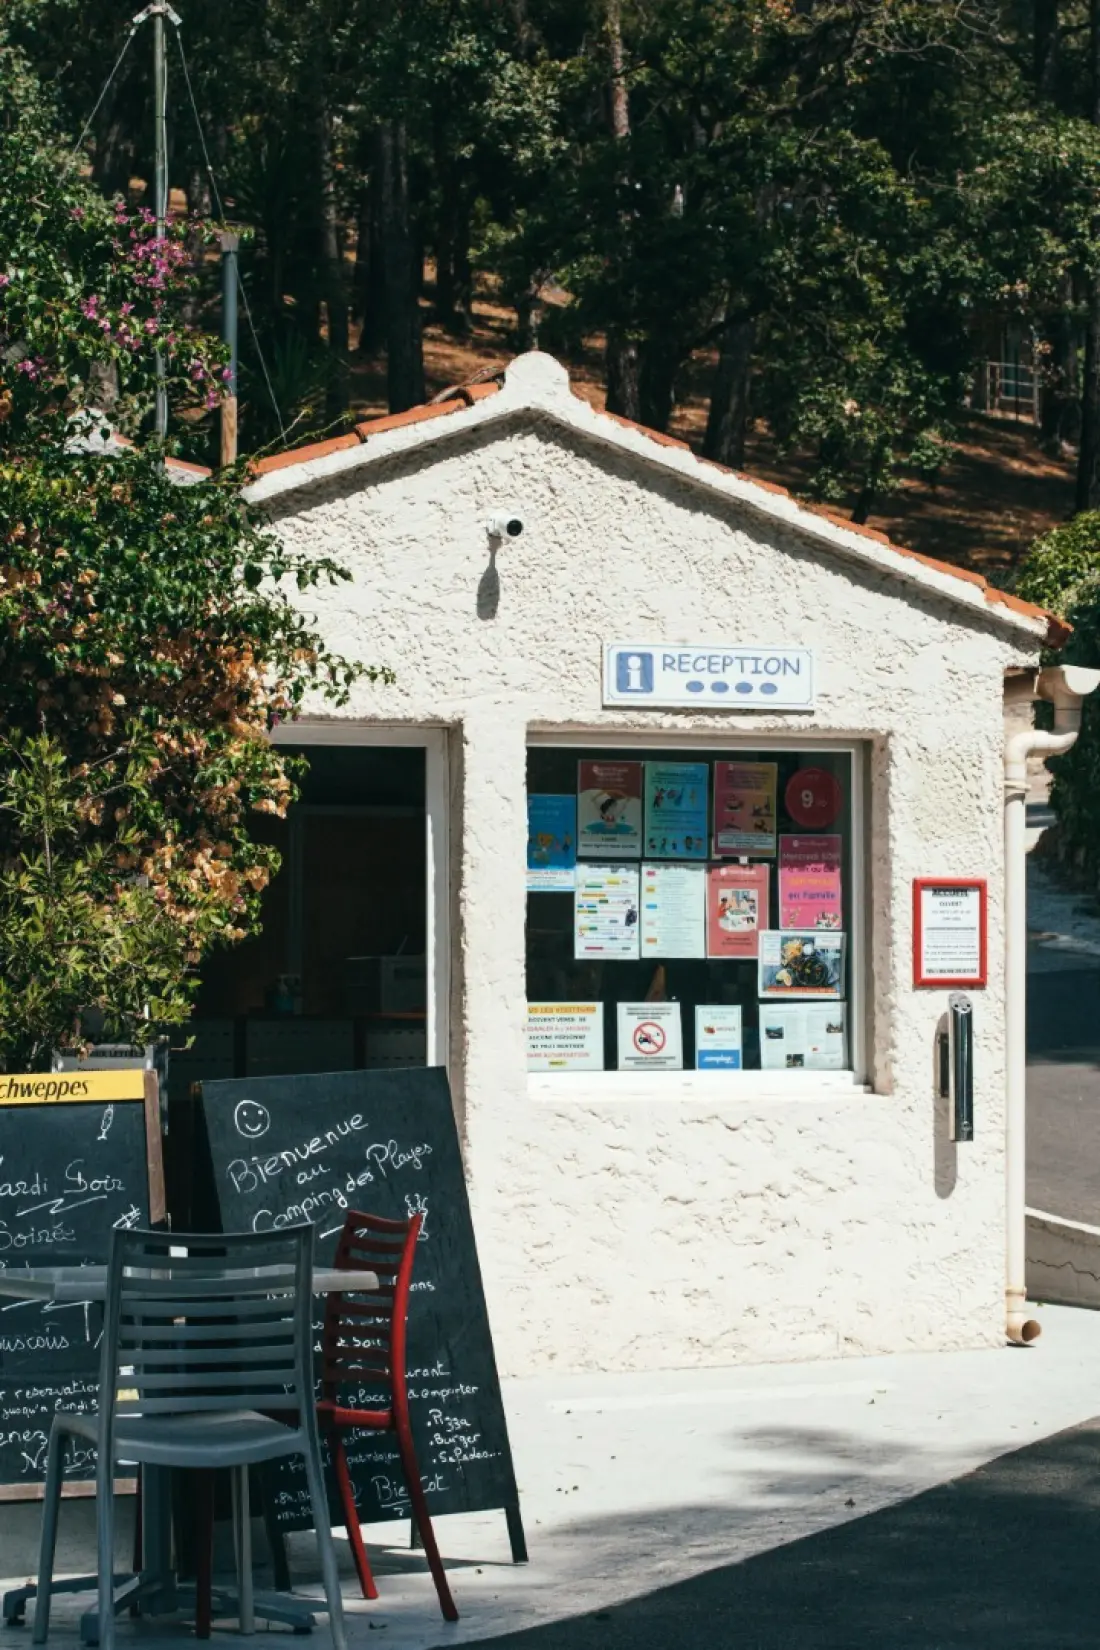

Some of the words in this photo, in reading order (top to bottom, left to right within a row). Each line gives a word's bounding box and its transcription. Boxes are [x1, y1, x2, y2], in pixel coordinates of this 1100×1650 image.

[661, 653, 801, 676] RECEPTION
[0, 1077, 91, 1100] chweppes
[226, 1113, 369, 1194] Bienvenue
[0, 1165, 48, 1197] ardi
[296, 1162, 331, 1185] au
[252, 1186, 349, 1233] Camping
[345, 1166, 375, 1193] des
[0, 1335, 70, 1352] uscous
[428, 1408, 472, 1432] Pizza
[0, 1429, 48, 1448] enez
[433, 1432, 482, 1448] Burger
